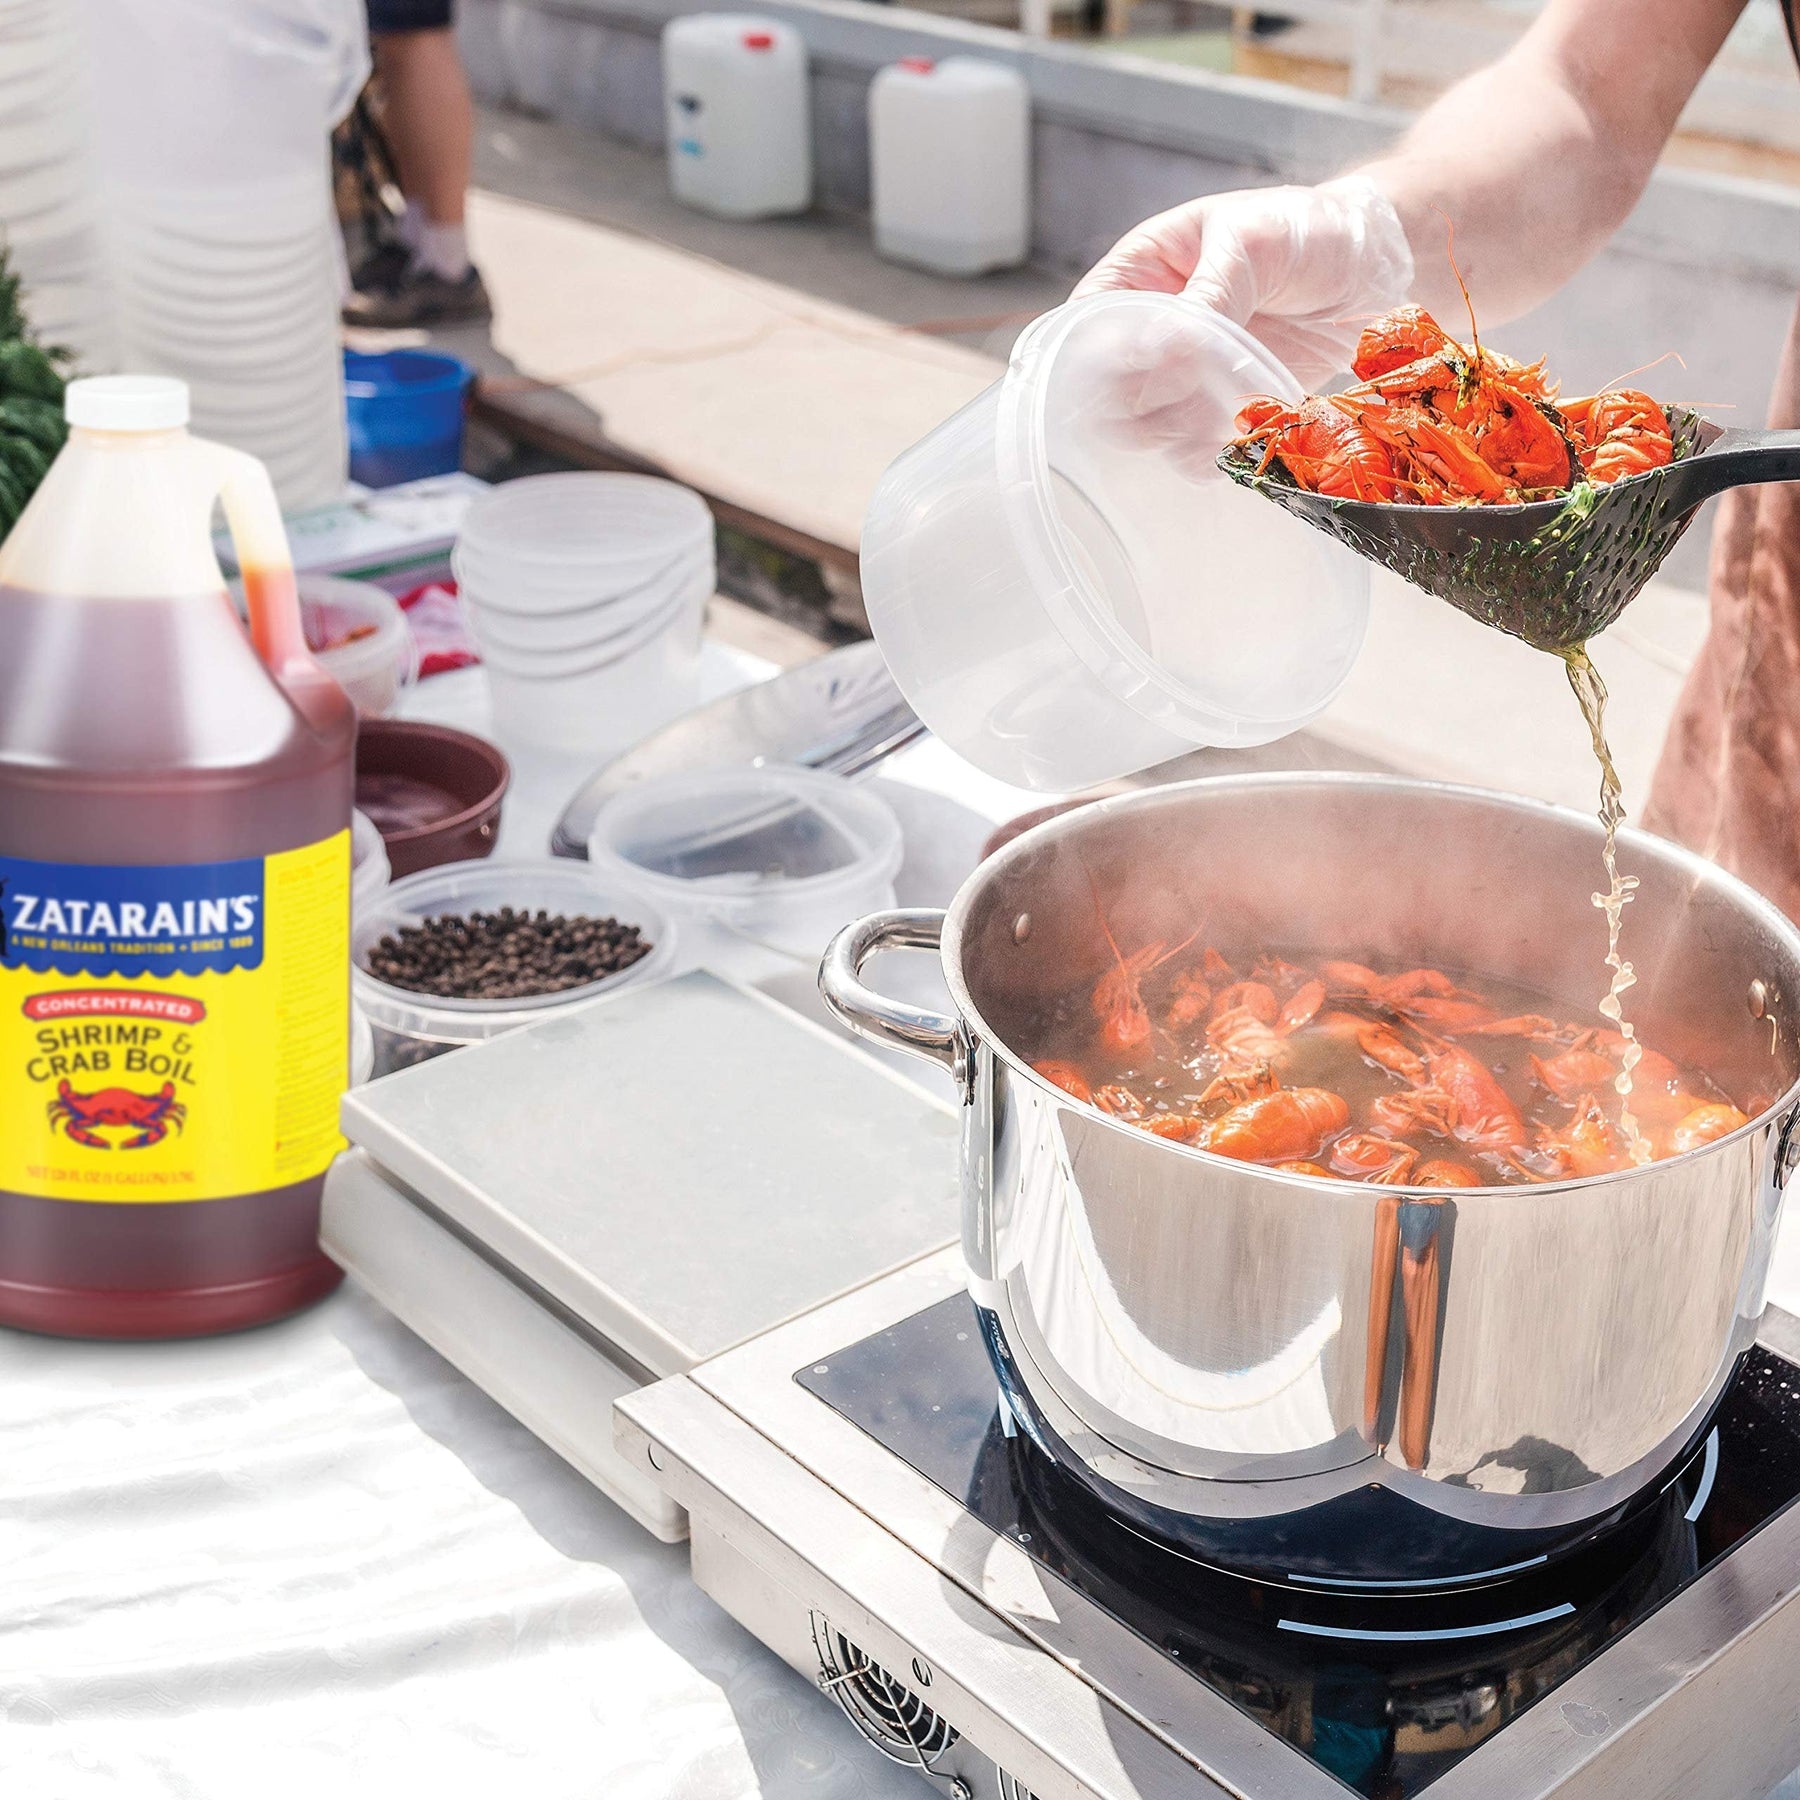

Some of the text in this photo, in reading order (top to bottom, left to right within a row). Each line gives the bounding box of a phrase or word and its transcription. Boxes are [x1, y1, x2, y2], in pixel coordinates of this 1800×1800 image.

[12, 894, 255, 937] ZATARAIN'S
[22, 935, 47, 949] NEW
[51, 938, 105, 954] ORLEANS
[110, 941, 175, 955] TRADITION
[191, 938, 224, 953] SINCE
[36, 996, 192, 1018] CONCENTRATED
[36, 1024, 193, 1055] SHRIMP &
[26, 1047, 196, 1086] CRAB BOIL
